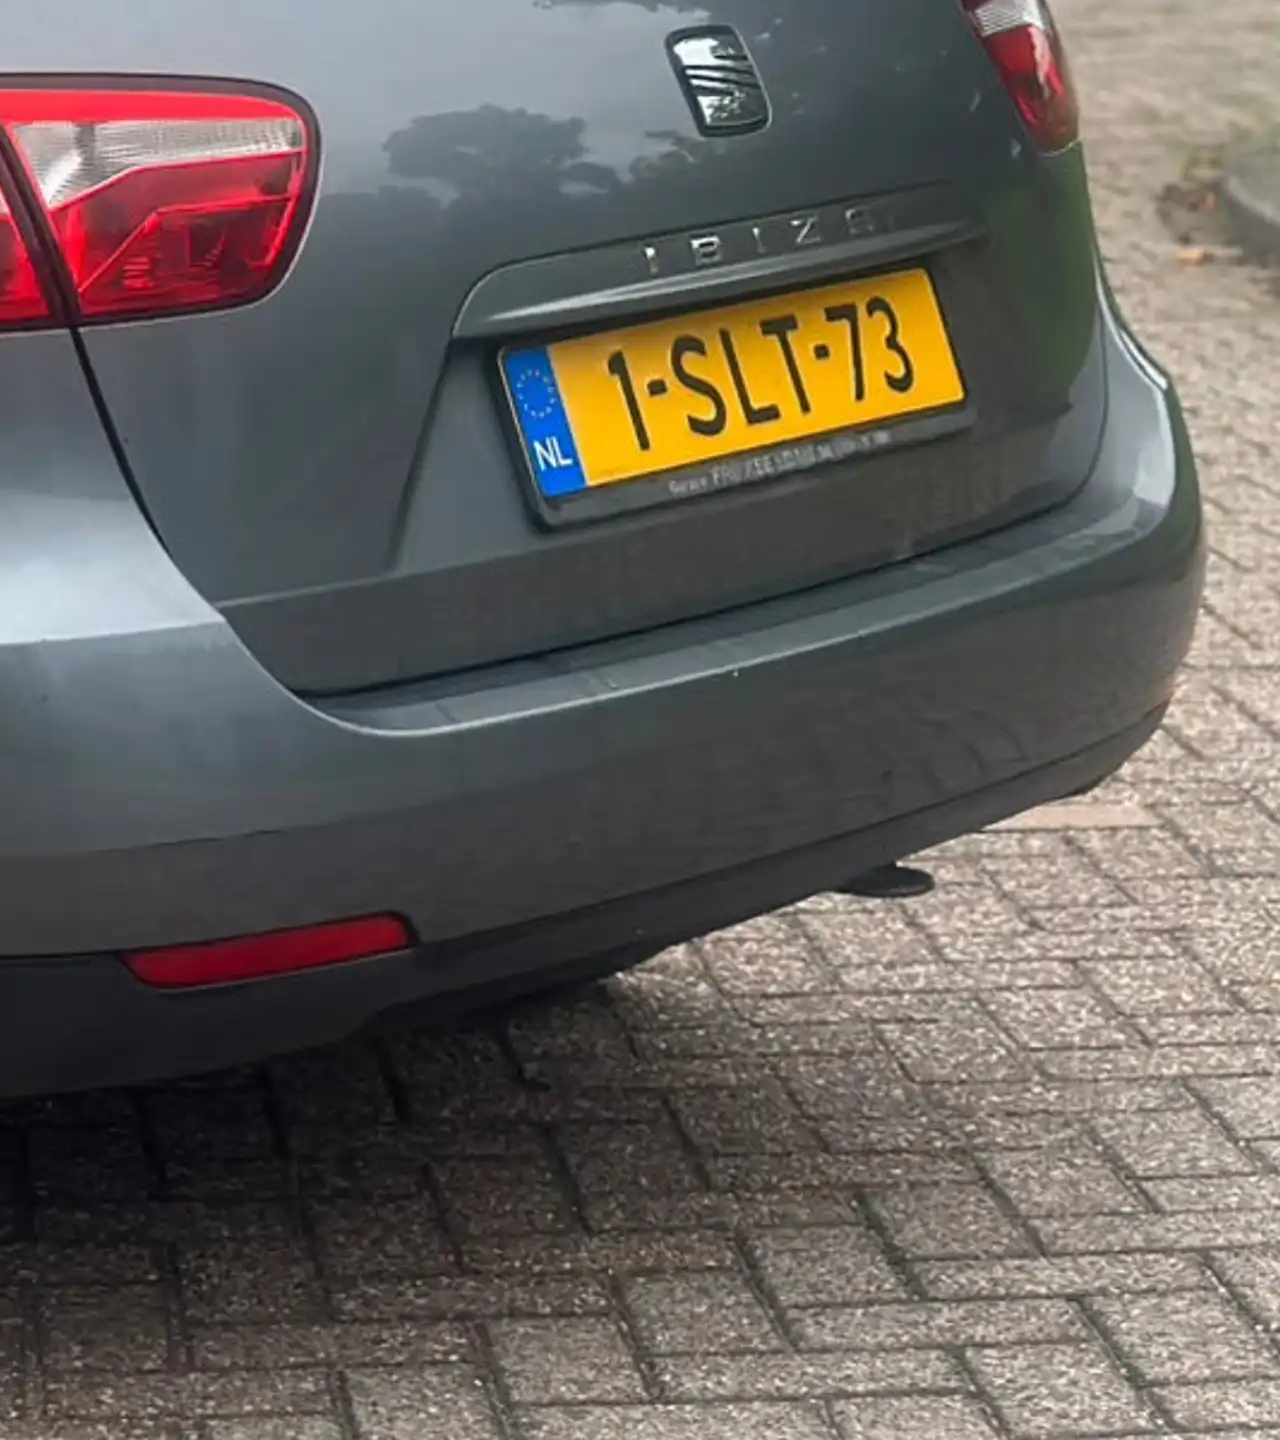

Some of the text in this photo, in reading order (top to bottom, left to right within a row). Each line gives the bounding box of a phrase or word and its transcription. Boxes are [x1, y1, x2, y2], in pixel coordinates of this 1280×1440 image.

[643, 208, 879, 274] IBIZA
[607, 296, 914, 452] 1-SLT-73
[534, 438, 573, 471] NL
